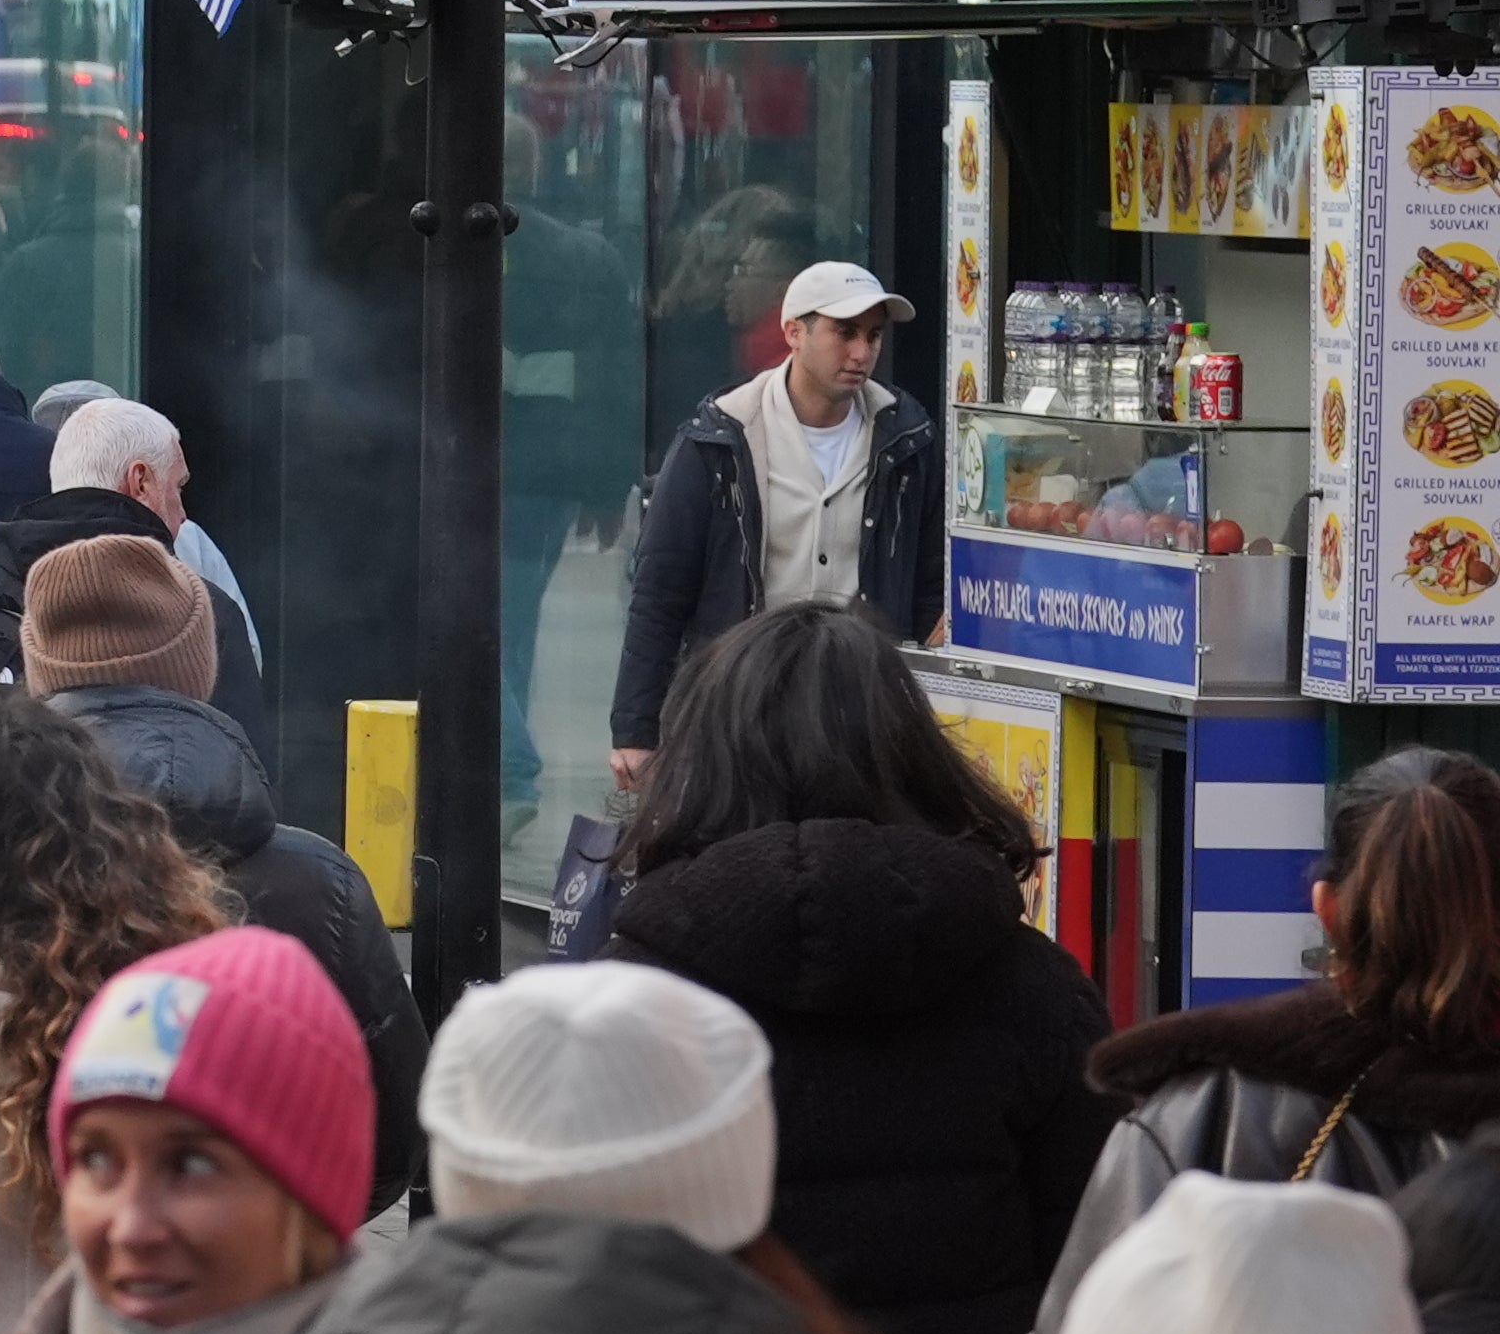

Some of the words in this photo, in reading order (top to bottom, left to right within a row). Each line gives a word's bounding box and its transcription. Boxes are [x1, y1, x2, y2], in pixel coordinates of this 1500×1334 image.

[1405, 203, 1455, 215] GRILLED
[1429, 220, 1489, 231] SOUVLAKI
[1391, 340, 1442, 352] GRILLED
[1446, 341, 1479, 352] LAMB
[1426, 357, 1486, 368] SOUVLAKI
[1394, 478, 1445, 489] GRILLED
[1423, 493, 1483, 505] SOUVLAKI
[1037, 587, 1079, 631] CHICKEN
[1080, 593, 1127, 637] SKEWERS
[1128, 609, 1146, 640] AND
[1148, 604, 1184, 646] DRINKS
[1407, 615, 1456, 626] FALAFEL
[1461, 615, 1495, 626] WRAP
